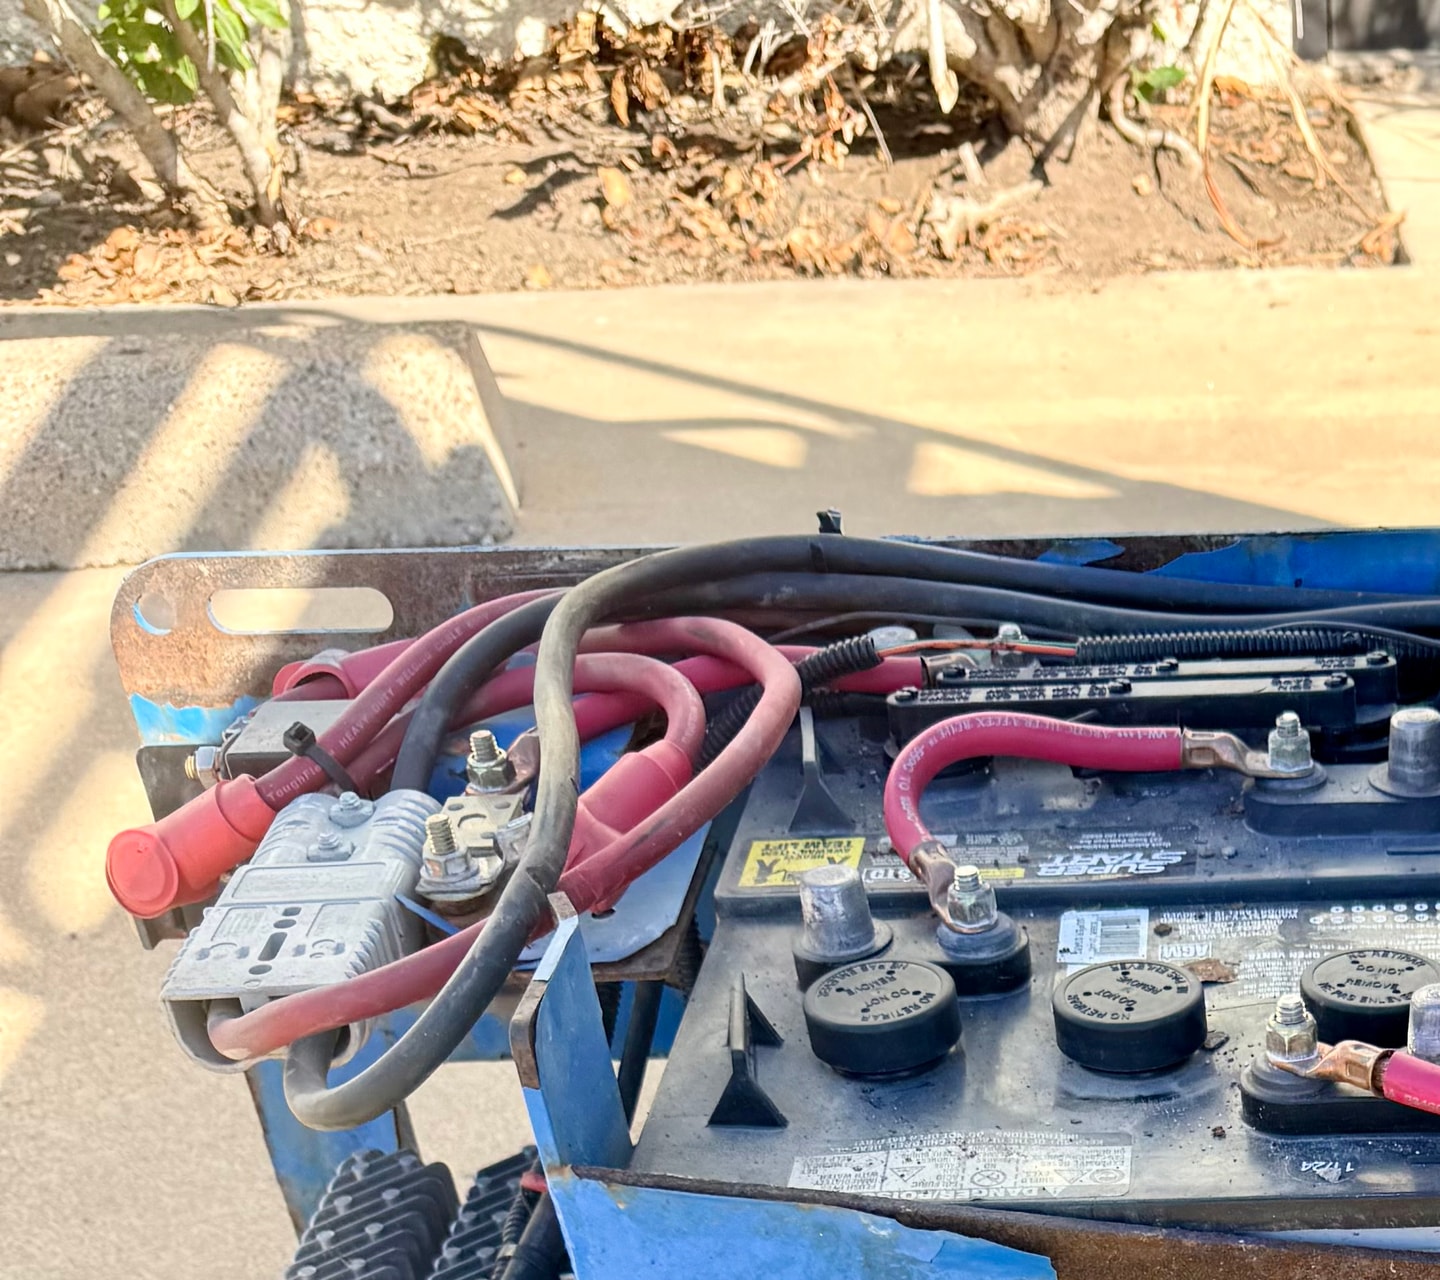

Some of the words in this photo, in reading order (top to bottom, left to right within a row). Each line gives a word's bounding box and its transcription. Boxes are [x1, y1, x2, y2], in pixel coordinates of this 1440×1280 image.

[266, 766, 324, 802] ToughFle
[1049, 850, 1187, 866] START
[1036, 863, 1166, 877] SUPER
[1159, 943, 1209, 960] AGM
[1355, 964, 1376, 973] DO
[1378, 967, 1405, 977] NOT
[844, 974, 897, 997] REMOVE
[1115, 974, 1163, 996] REMOVE
[1345, 978, 1400, 990] REMOVE
[890, 988, 910, 999] DO
[1093, 988, 1118, 1001] NOT
[862, 995, 890, 1009] NOT
[860, 1002, 922, 1022] RETIRAR
[856, 1187, 1039, 1201] DANGER/POIS
